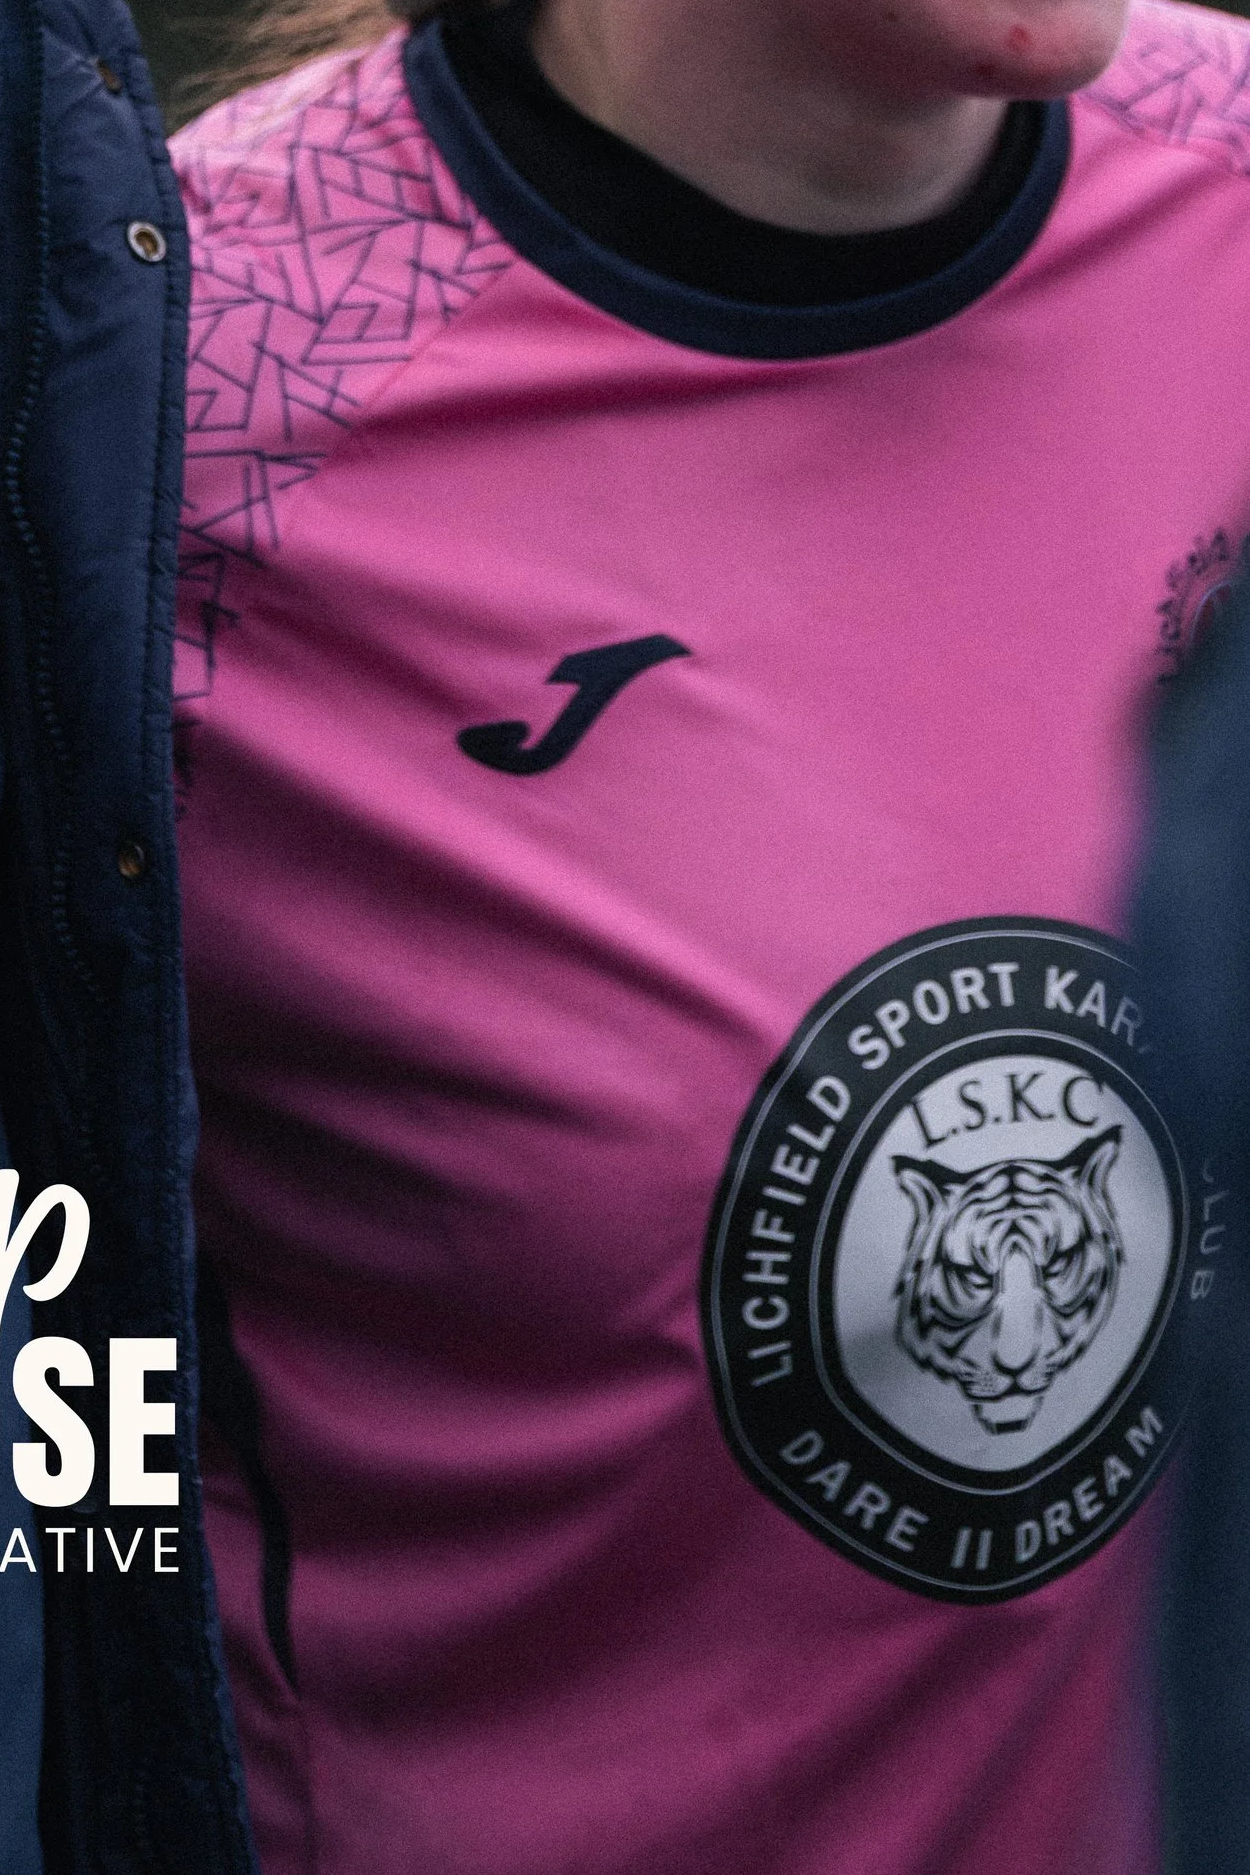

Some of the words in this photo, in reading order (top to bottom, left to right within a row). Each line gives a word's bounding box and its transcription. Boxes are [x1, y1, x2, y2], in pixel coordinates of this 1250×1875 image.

[741, 1074, 852, 1387] LICHFIELD
[848, 962, 1021, 1070] SPORT
[1044, 964, 1150, 1055] KAR
[781, 1428, 929, 1553] DARE
[951, 1528, 993, 1570] II
[1013, 1405, 1164, 1564] DREAM
